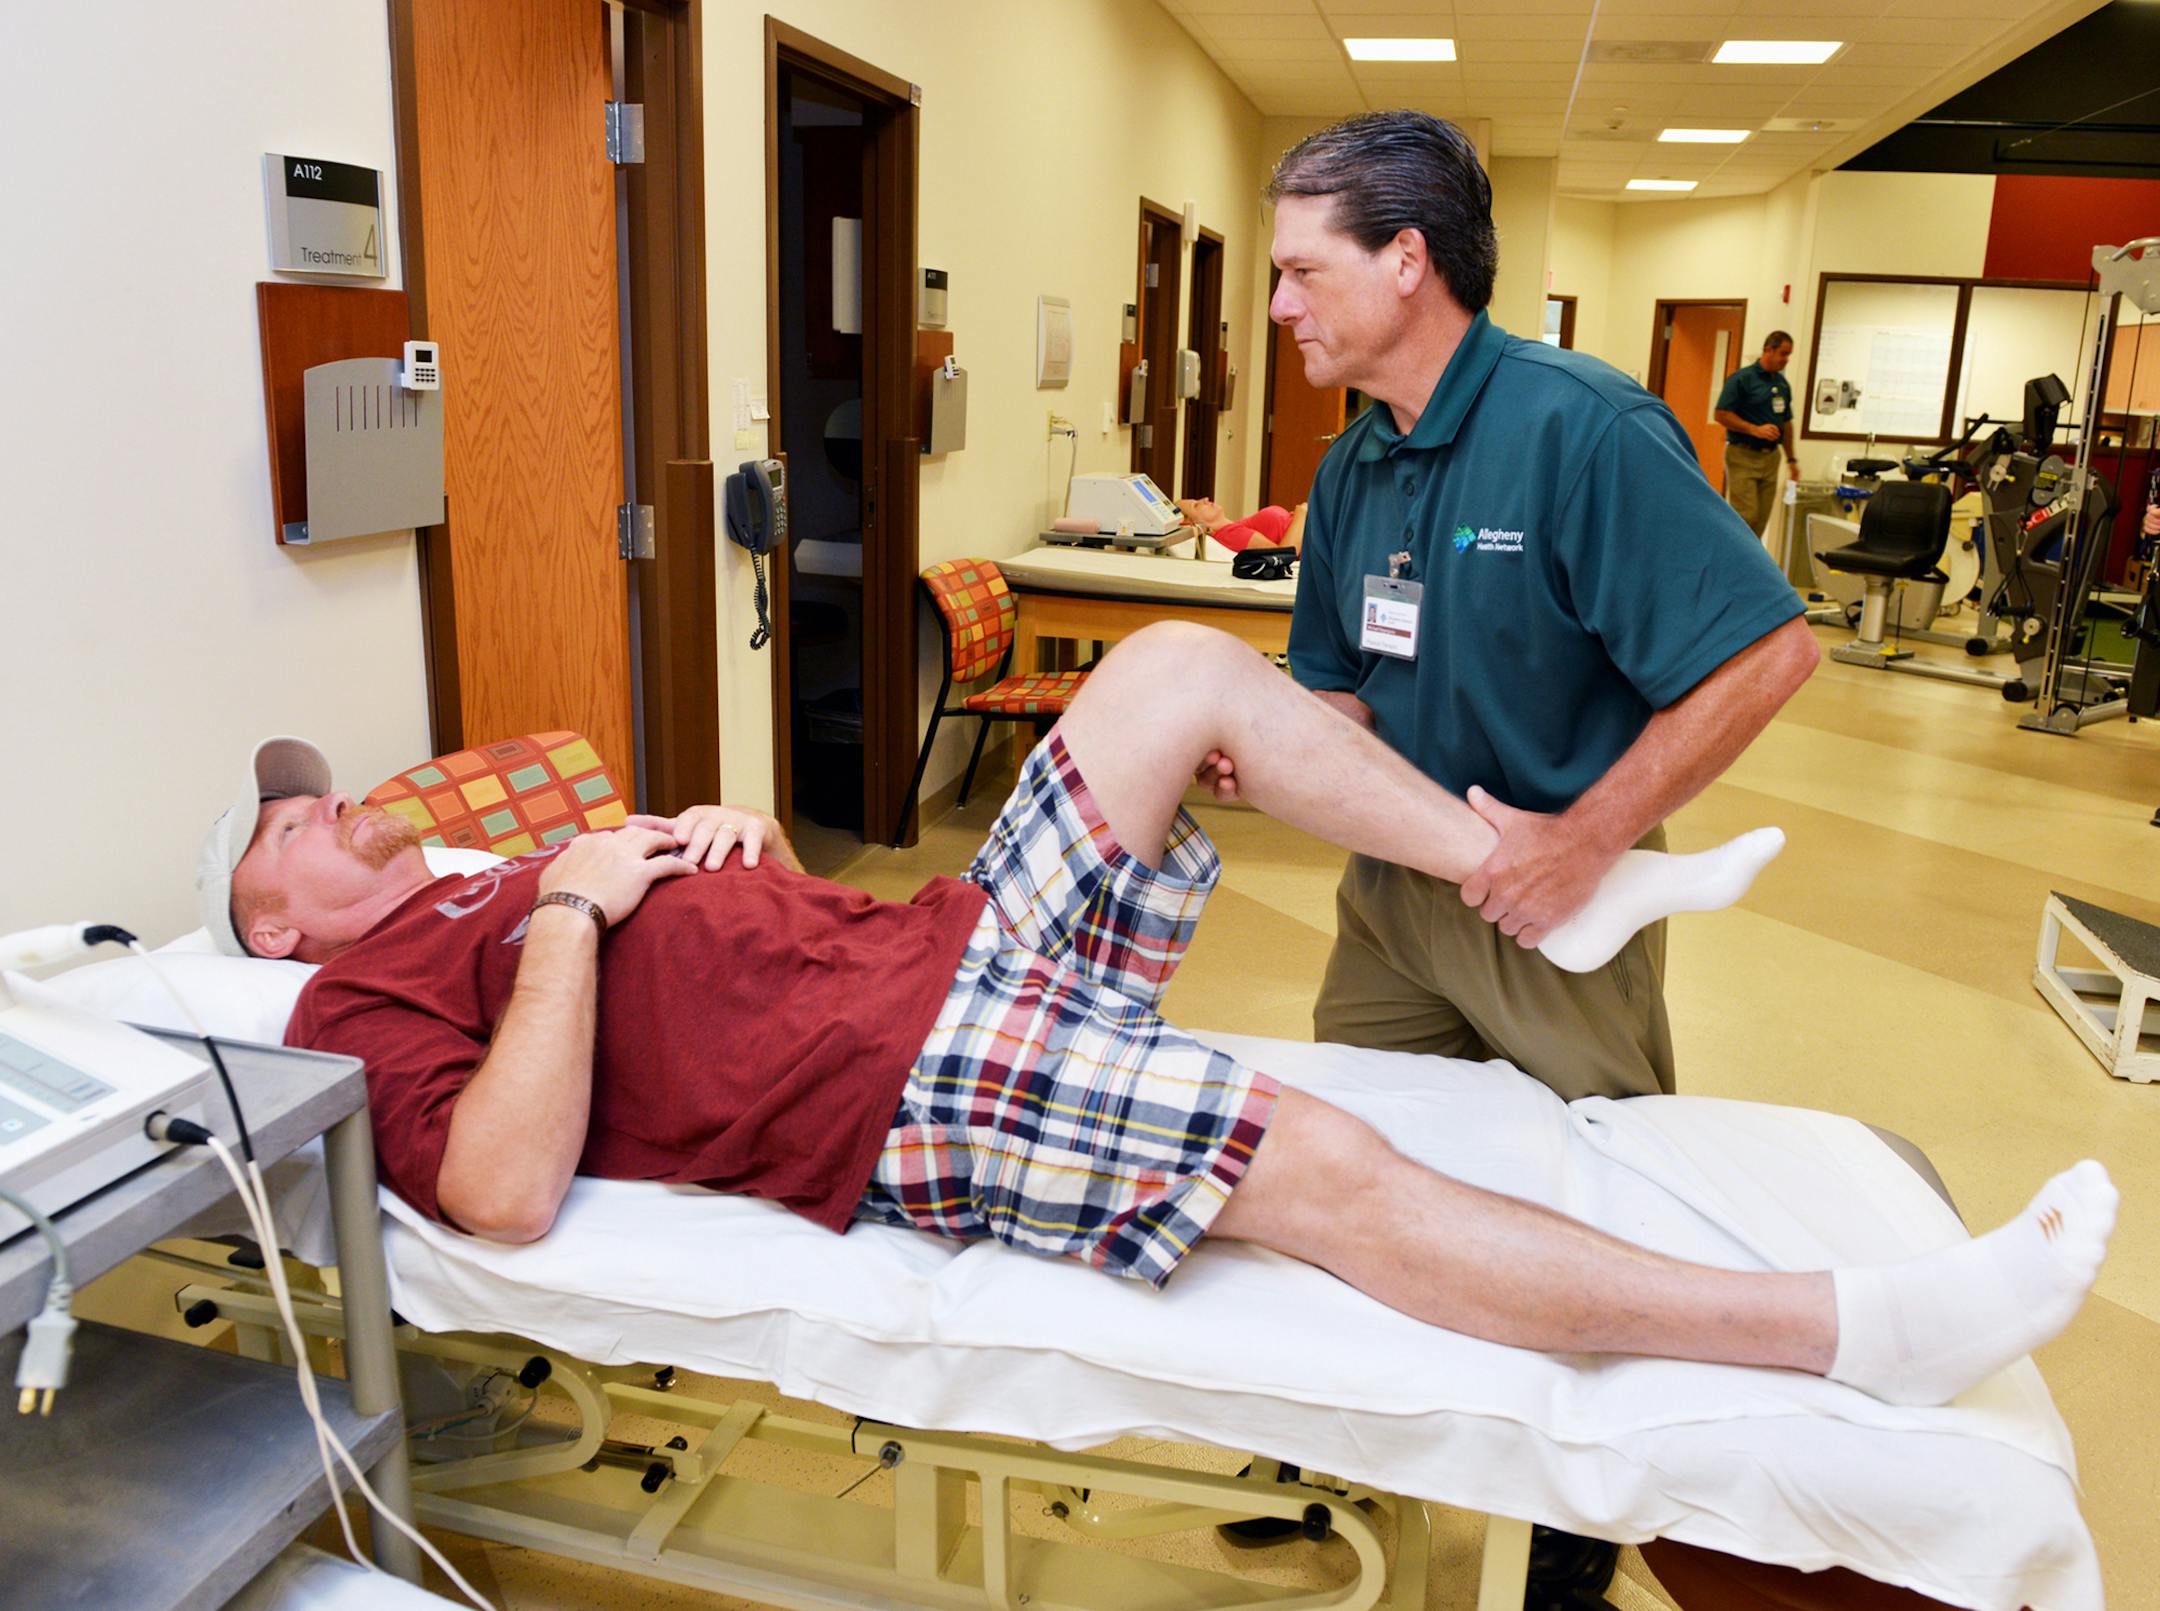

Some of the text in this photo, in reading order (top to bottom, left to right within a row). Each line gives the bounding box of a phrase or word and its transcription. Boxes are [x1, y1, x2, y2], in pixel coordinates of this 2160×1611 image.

[293, 163, 323, 181] A112
[300, 223, 378, 268] Treatment 4
[1477, 527, 1524, 544] Allegheny
